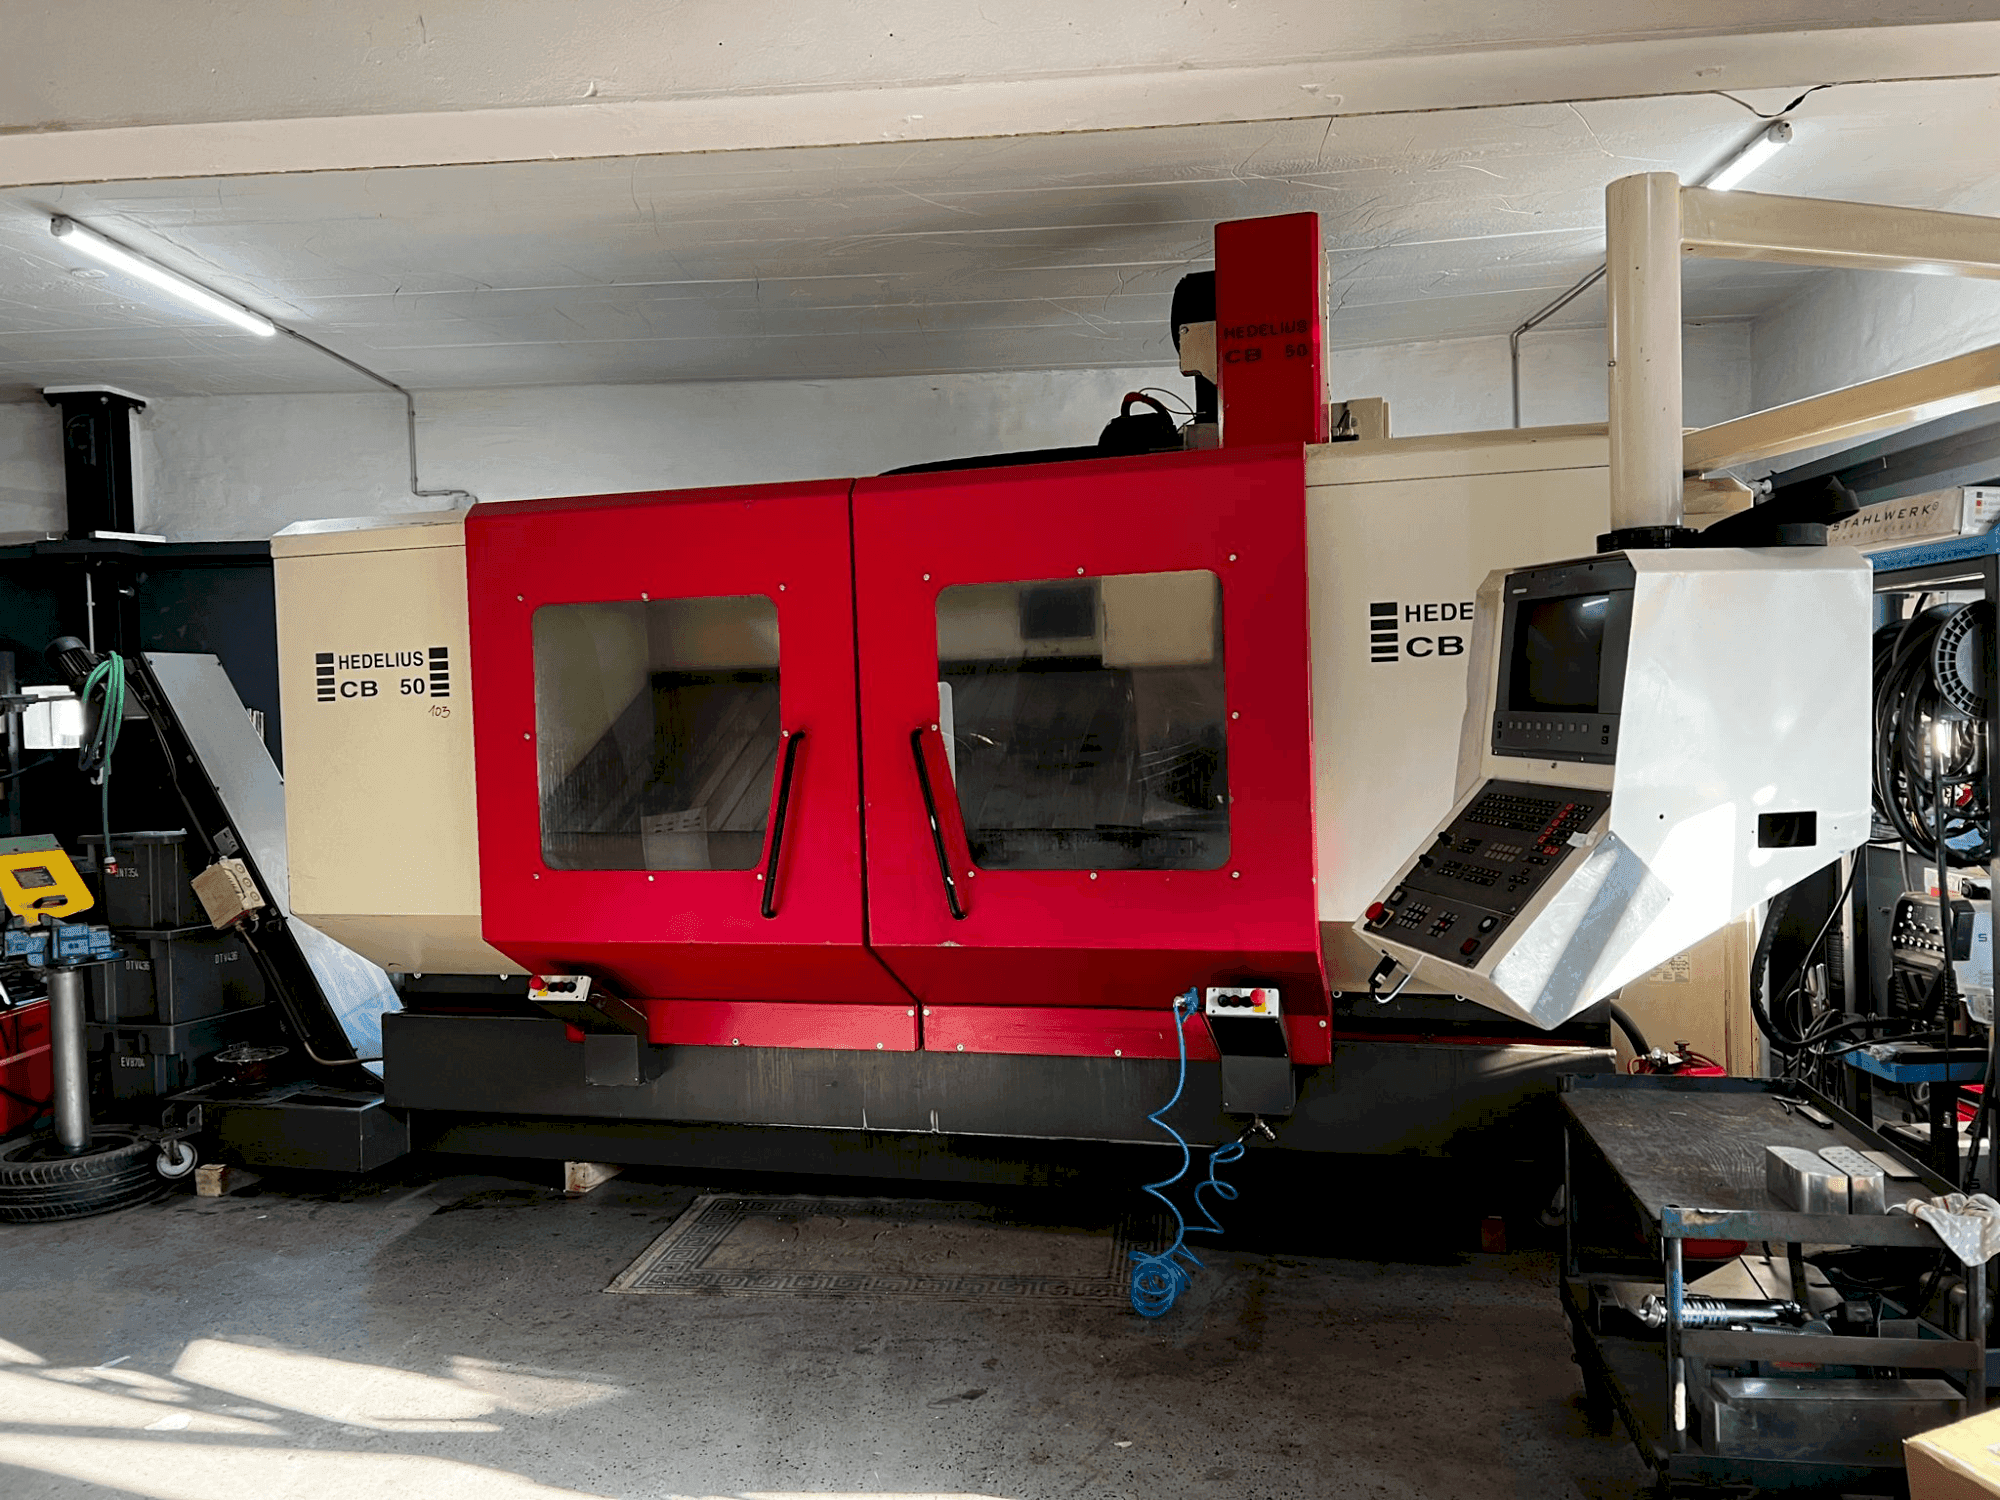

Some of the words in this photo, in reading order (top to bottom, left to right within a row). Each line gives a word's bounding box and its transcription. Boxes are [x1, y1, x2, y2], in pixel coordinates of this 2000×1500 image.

[1224, 319, 1308, 339] HEDELIUS
[1225, 348, 1262, 364] CB
[1285, 343, 1308, 358] 50
[1406, 636, 1464, 657] CB
[339, 651, 424, 670] HEDELIUS
[340, 680, 378, 698] CB
[400, 678, 425, 695] 50
[428, 705, 450, 718] 103
